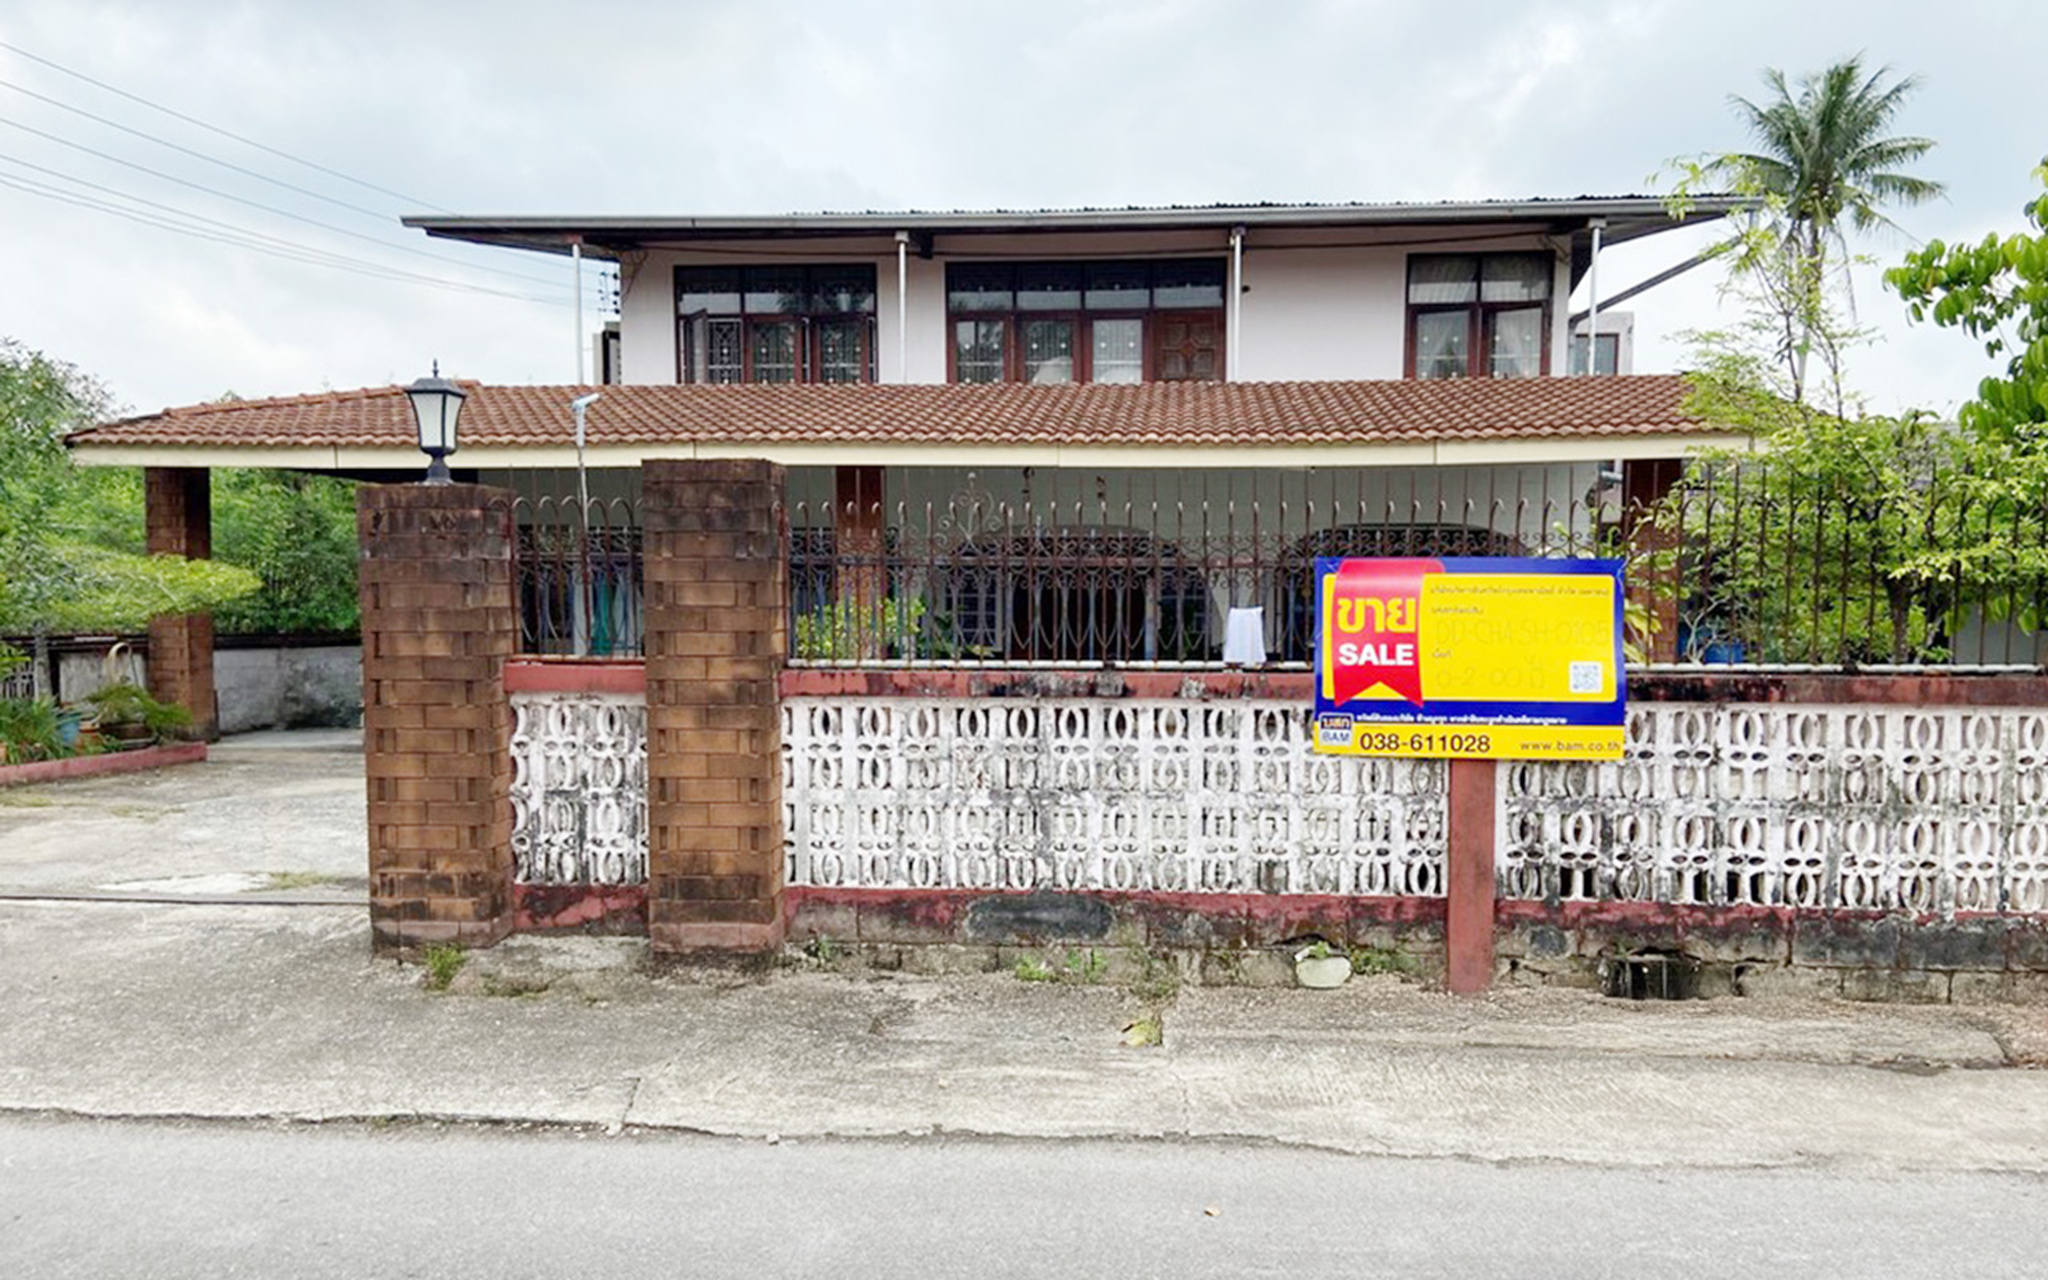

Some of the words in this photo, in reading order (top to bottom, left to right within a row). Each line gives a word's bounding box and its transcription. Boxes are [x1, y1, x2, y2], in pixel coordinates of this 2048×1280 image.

[1337, 597, 1416, 633] ขาย
[1338, 643, 1414, 666] SALE
[1322, 731, 1350, 742] BAM
[1359, 732, 1491, 753] 038-611028
[1520, 741, 1621, 752] www.bam.co.th
